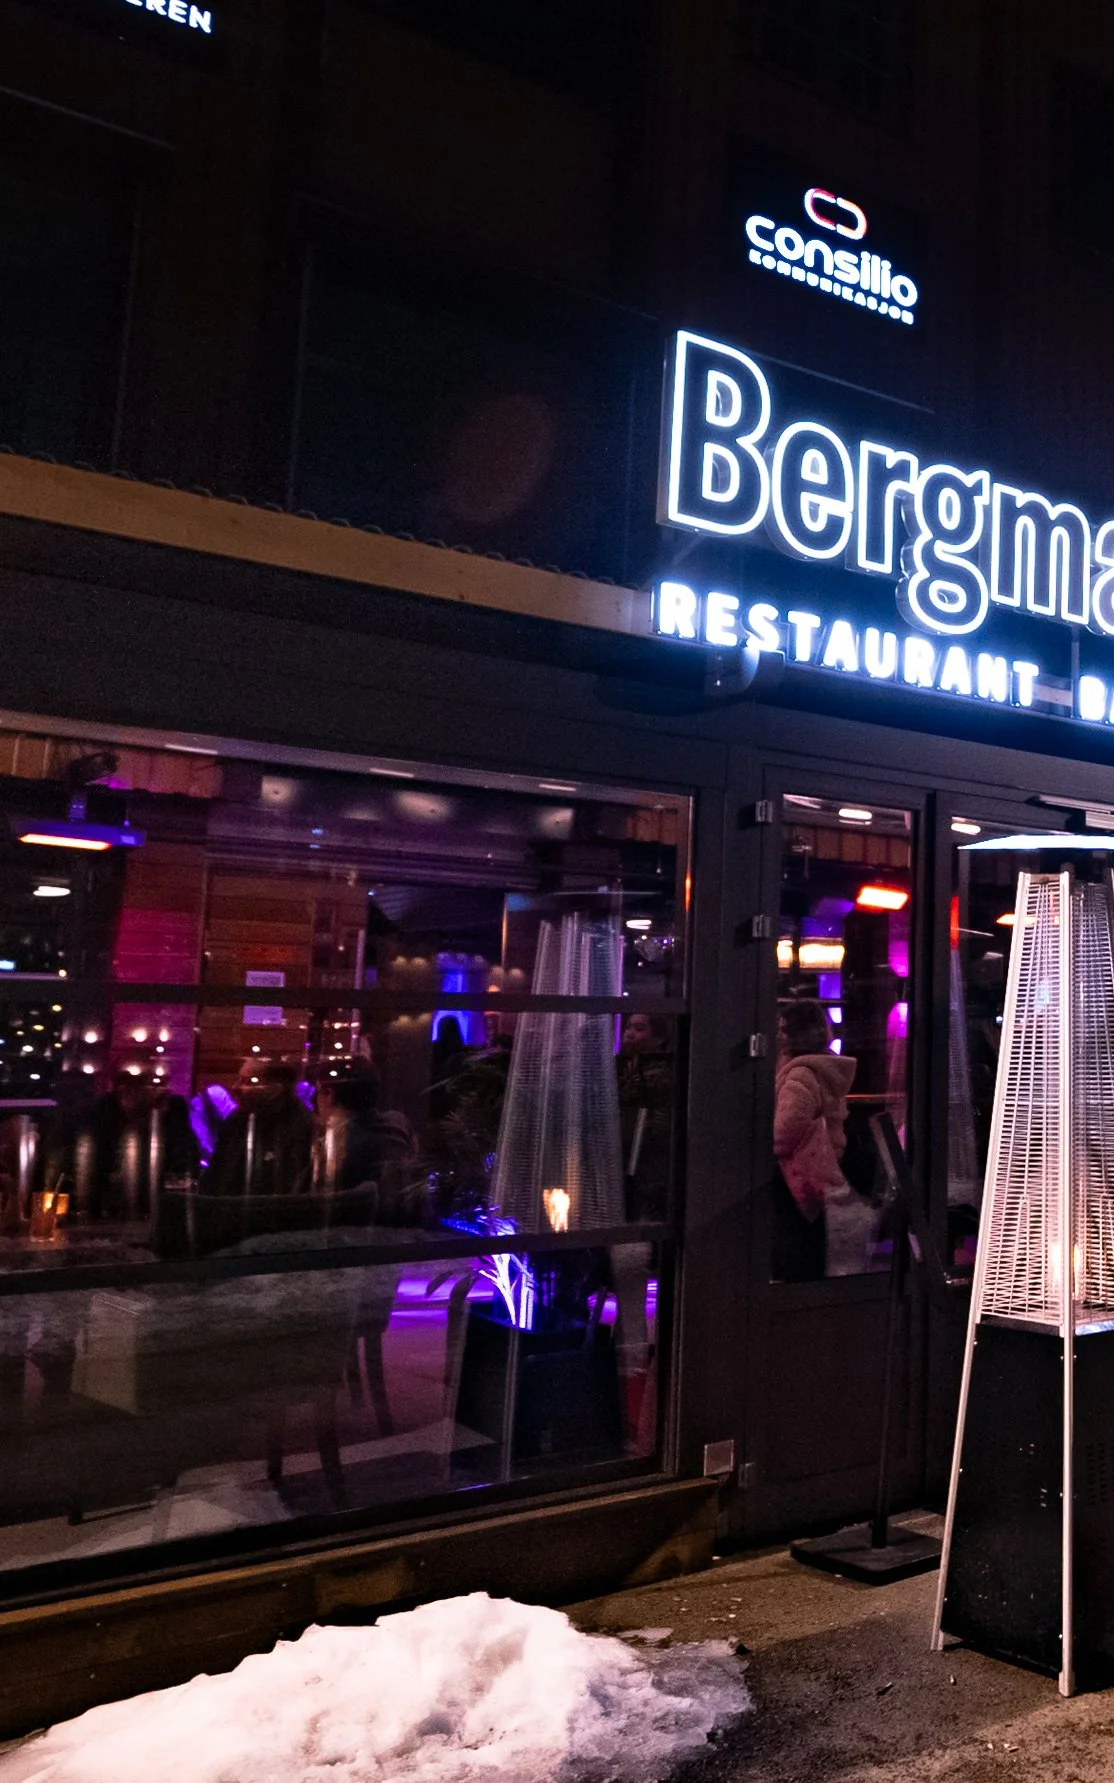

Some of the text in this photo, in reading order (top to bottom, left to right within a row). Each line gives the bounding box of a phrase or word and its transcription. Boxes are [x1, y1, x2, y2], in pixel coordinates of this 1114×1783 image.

[126, 0, 211, 33] REN
[746, 215, 918, 307] consilio
[659, 581, 1040, 707] RESTAURANT
